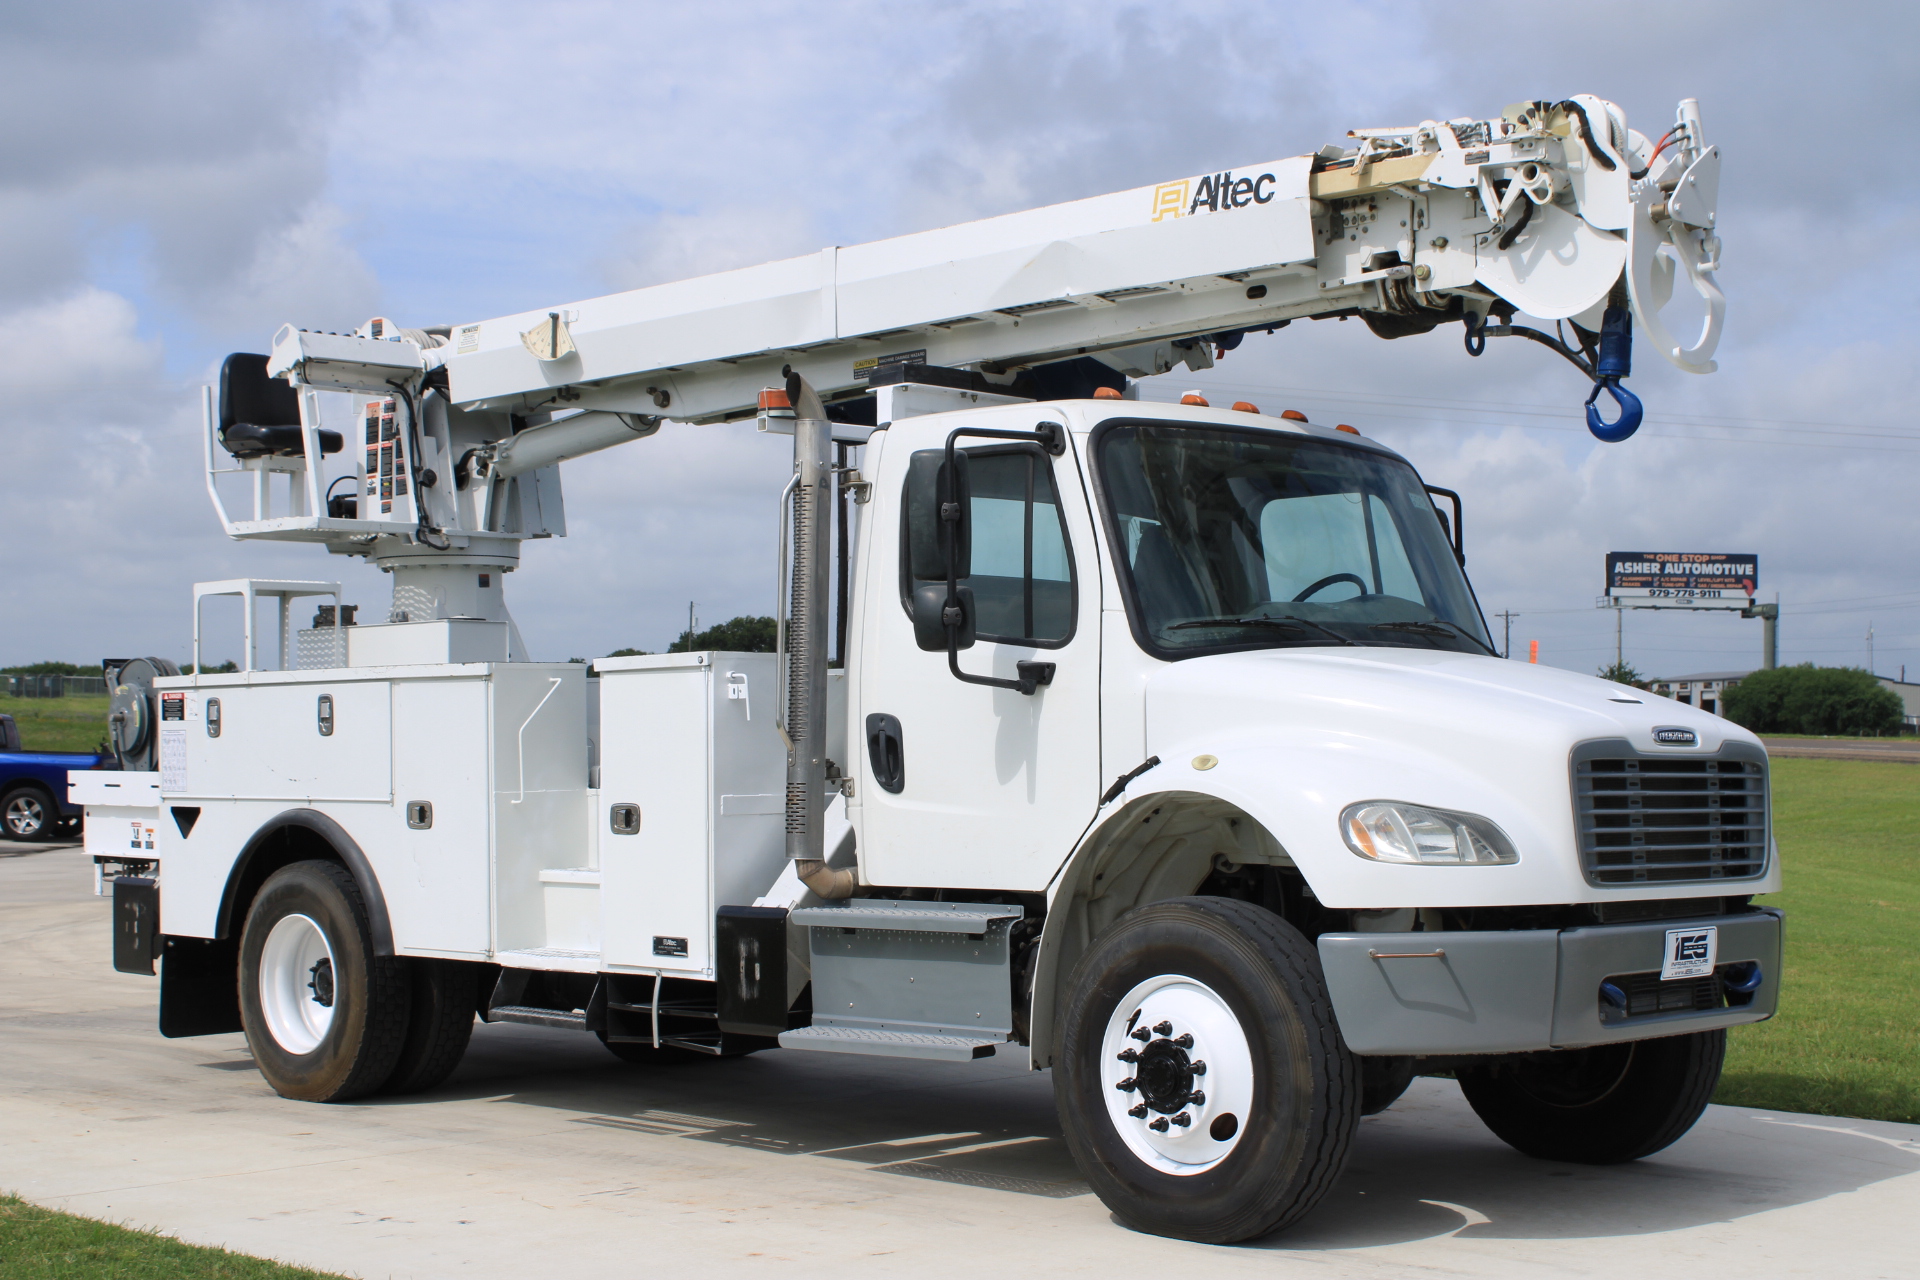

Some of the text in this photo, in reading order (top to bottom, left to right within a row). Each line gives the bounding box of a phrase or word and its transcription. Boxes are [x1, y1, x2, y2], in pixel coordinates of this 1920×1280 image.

[1188, 171, 1276, 215] Altec
[855, 359, 877, 368] CAUTION
[1656, 554, 1680, 562] ONE
[1681, 554, 1710, 562] STOP
[1614, 561, 1754, 575] ASHER AUTOMOTIVE
[1648, 588, 1722, 598] 979-778-9111
